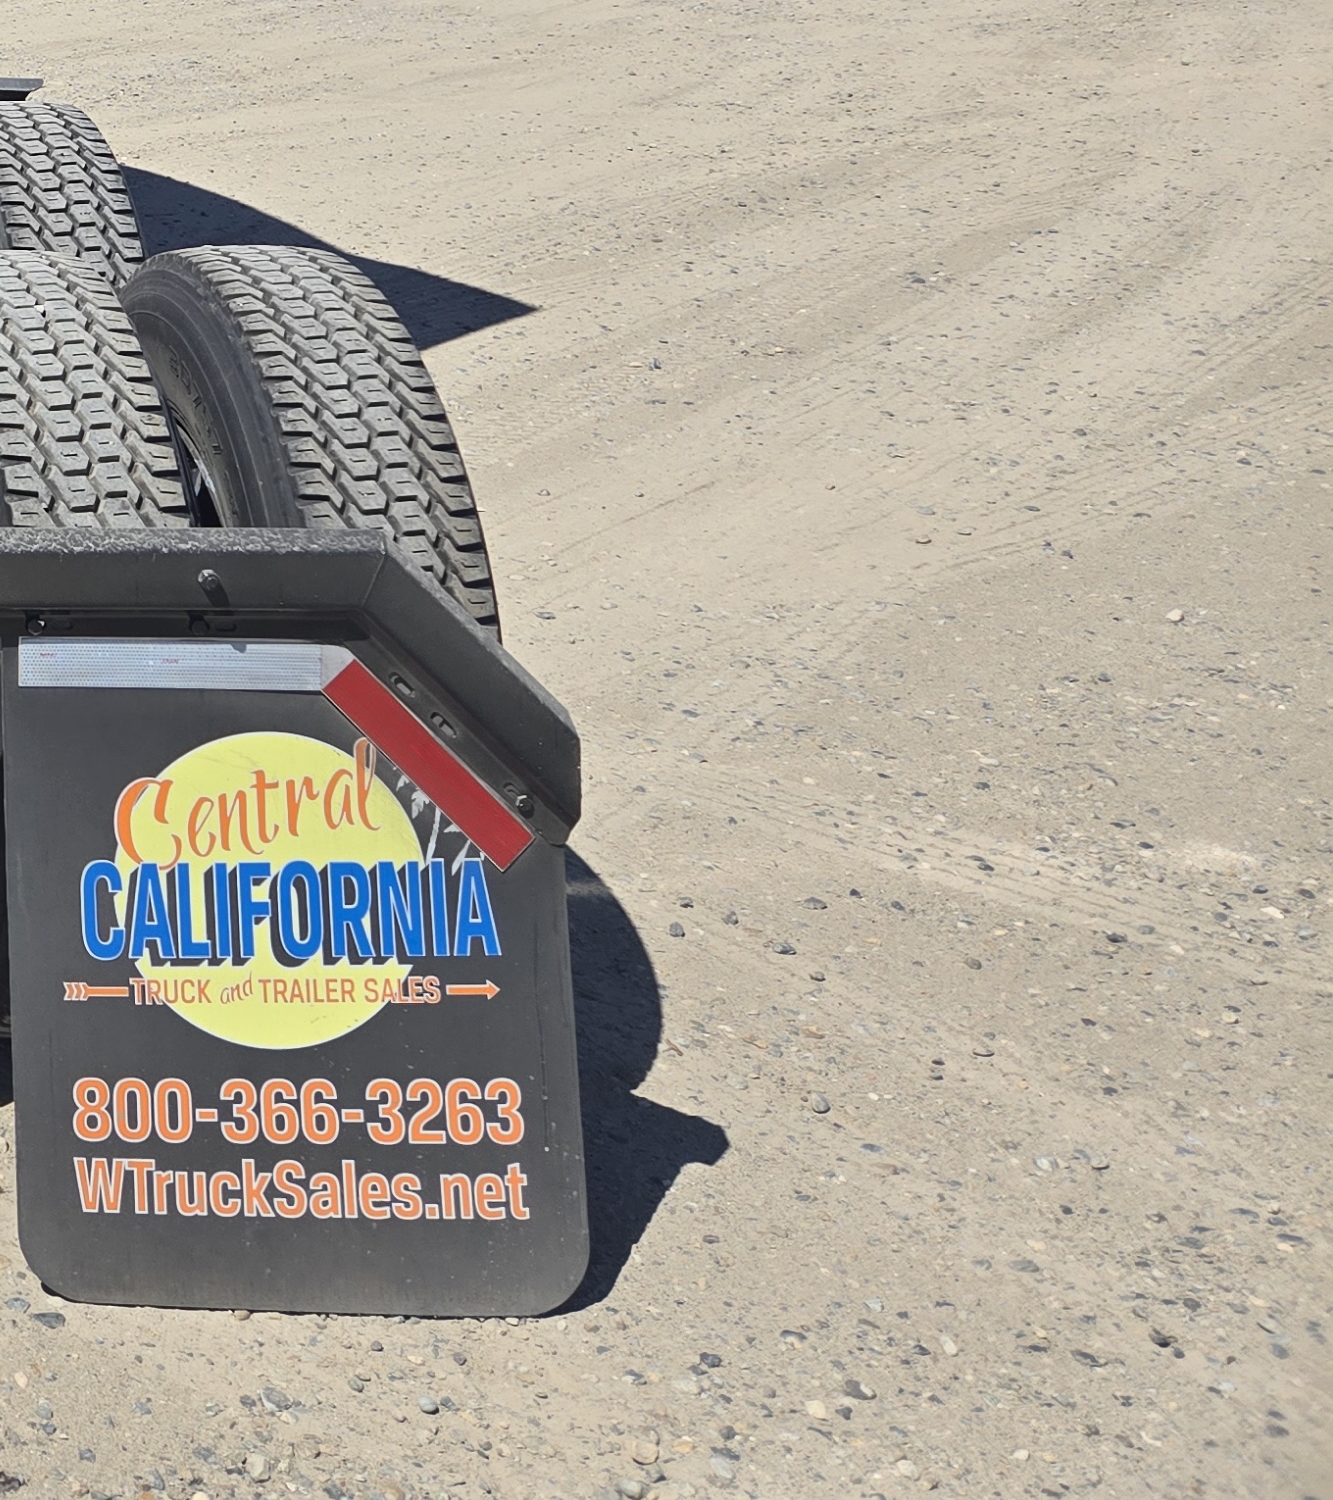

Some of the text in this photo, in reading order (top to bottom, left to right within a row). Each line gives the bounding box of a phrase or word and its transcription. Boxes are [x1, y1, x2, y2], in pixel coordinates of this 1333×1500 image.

[115, 737, 381, 871] Central
[81, 857, 501, 961] CALIFORNIA
[131, 973, 441, 1005] TRUCK and TRAILER SALES
[72, 1076, 525, 1145] 800-366-3263
[74, 1155, 529, 1220] WTruckSales.net
